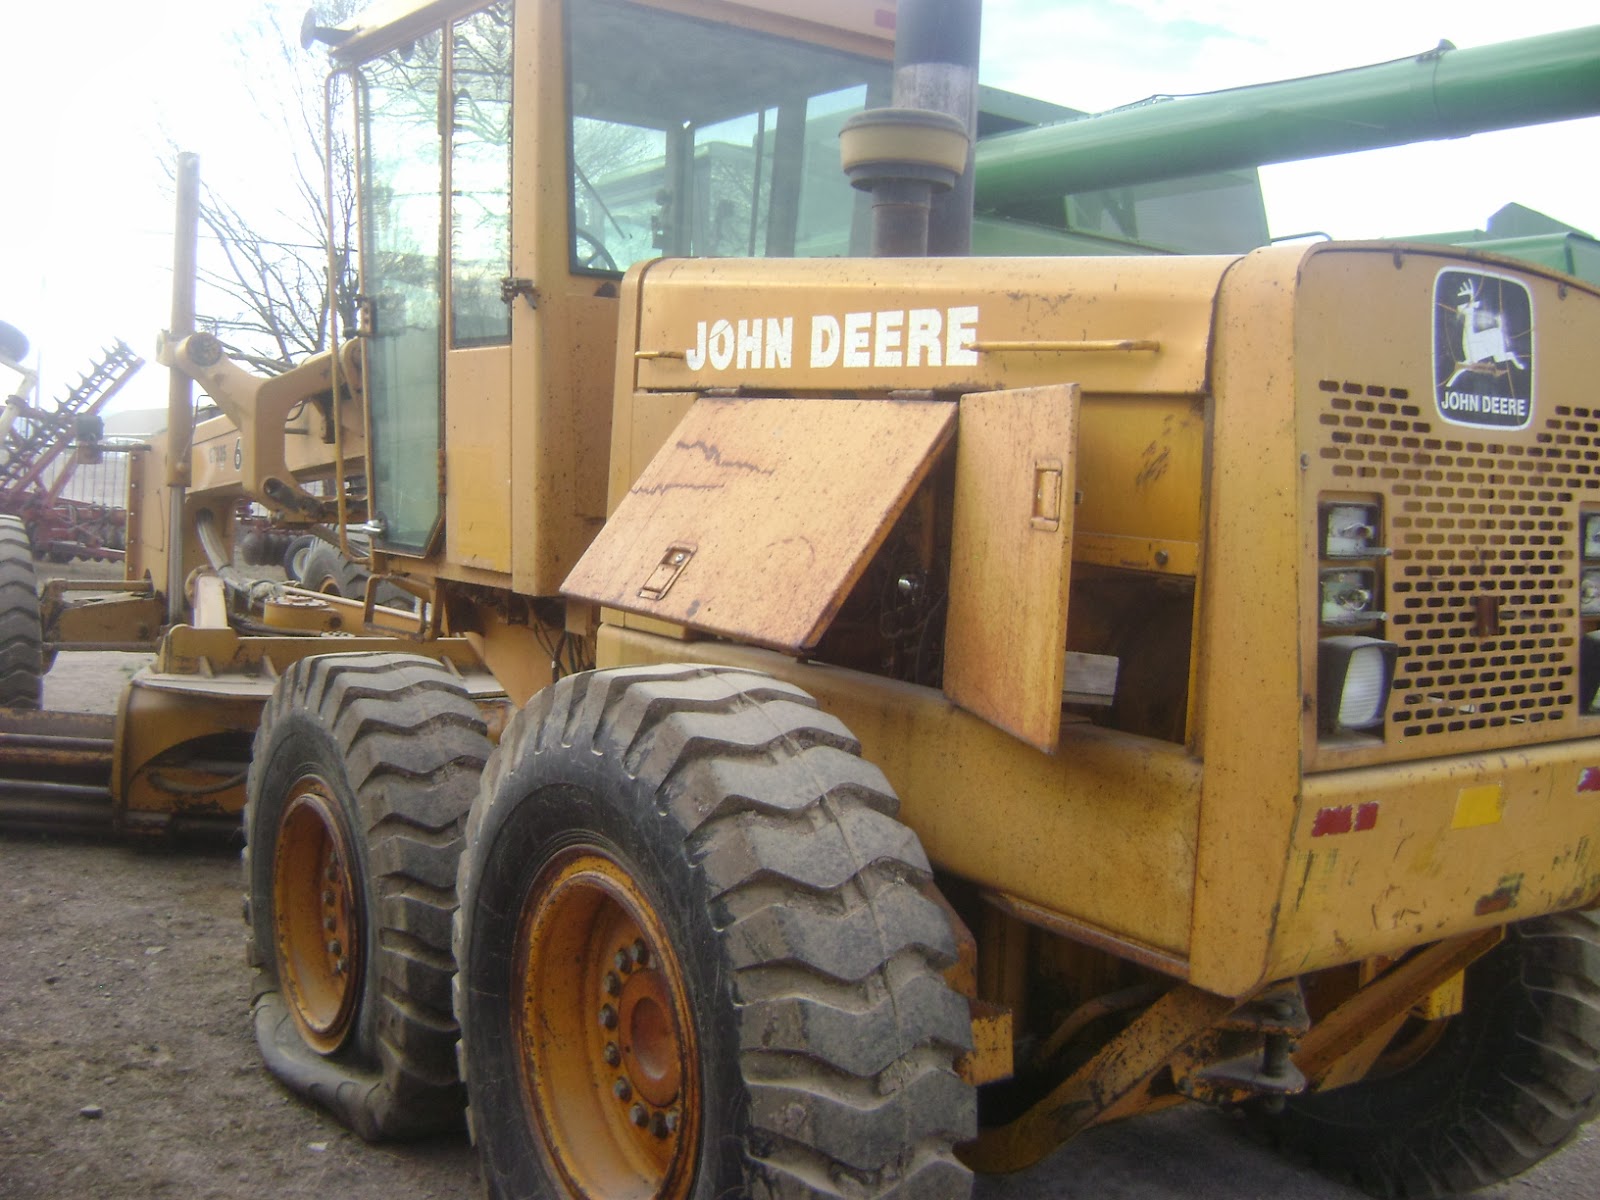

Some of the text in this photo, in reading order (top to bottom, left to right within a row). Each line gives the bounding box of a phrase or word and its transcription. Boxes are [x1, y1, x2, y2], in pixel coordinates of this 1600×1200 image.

[686, 306, 979, 371] JOHN DEERE
[1441, 391, 1526, 417] JOHN DEERE
